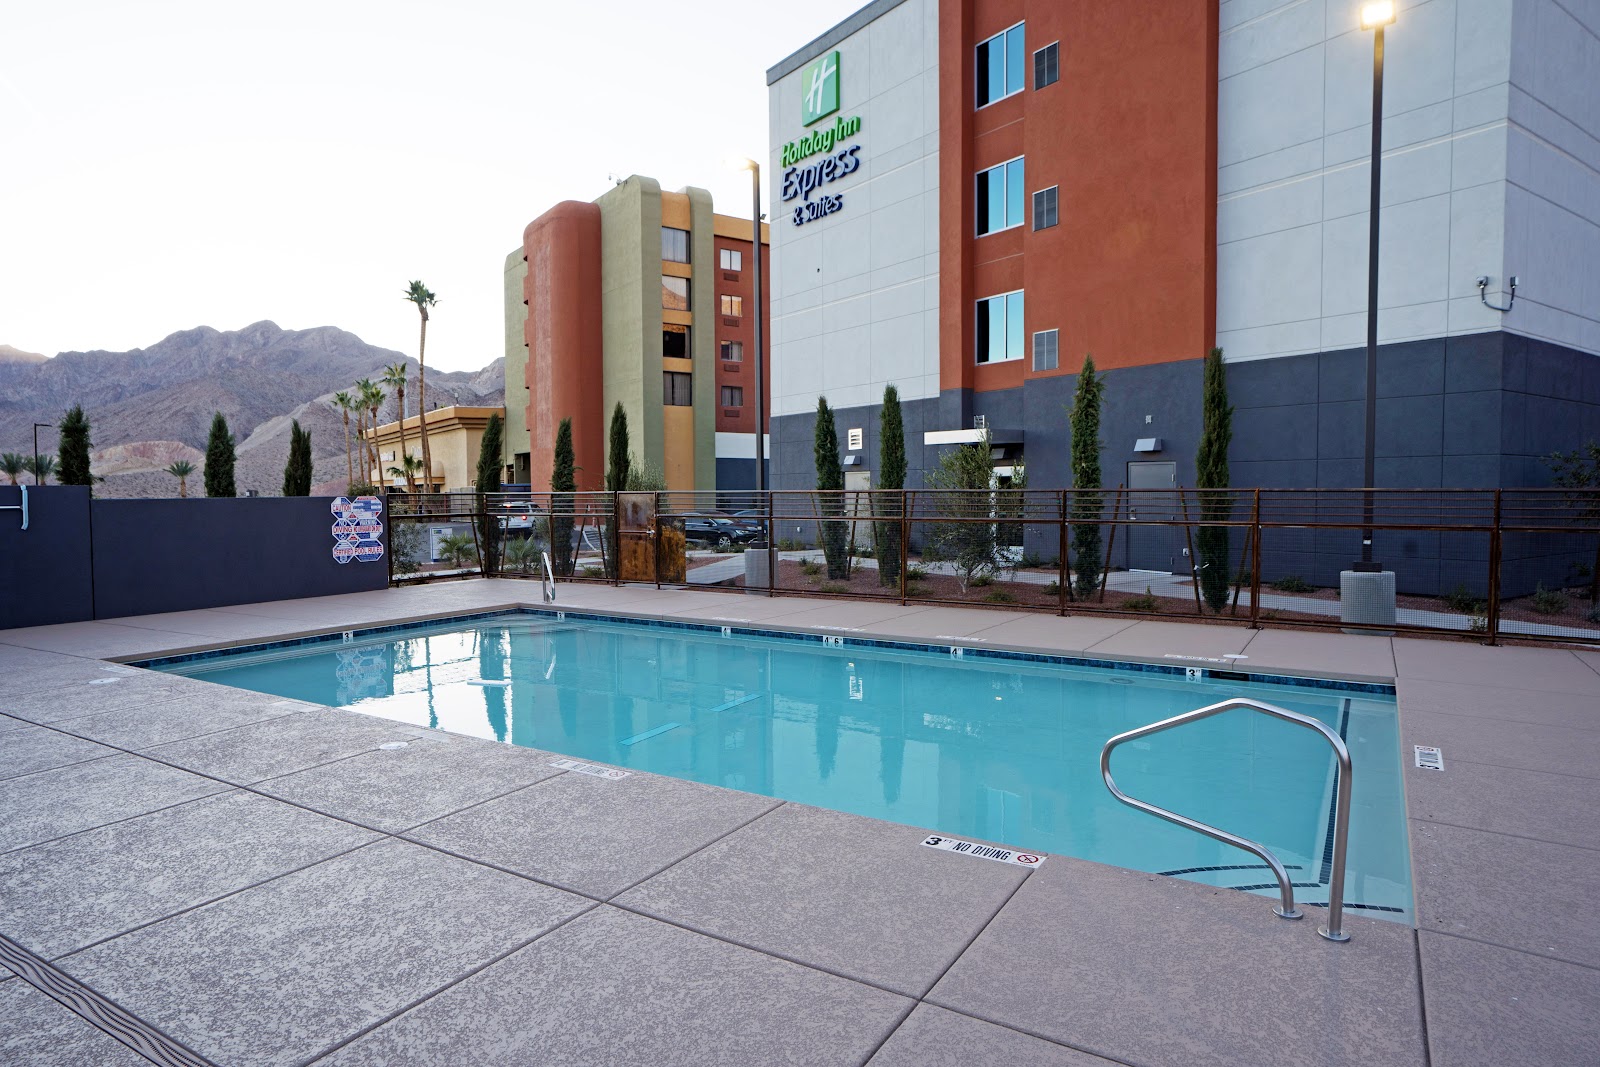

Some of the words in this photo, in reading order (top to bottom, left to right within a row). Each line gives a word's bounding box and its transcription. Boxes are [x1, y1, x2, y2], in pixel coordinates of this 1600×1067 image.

[780, 128, 836, 168] Holiday
[834, 116, 861, 142] Inn
[781, 145, 861, 201] Express
[792, 206, 804, 227] &
[802, 194, 843, 223] Suites
[332, 504, 351, 512] CAUTION
[354, 547, 367, 555] POOL
[368, 546, 383, 554] RULES
[925, 837, 942, 846] 3
[952, 842, 972, 852] NO
[971, 845, 1012, 861] DIVING
